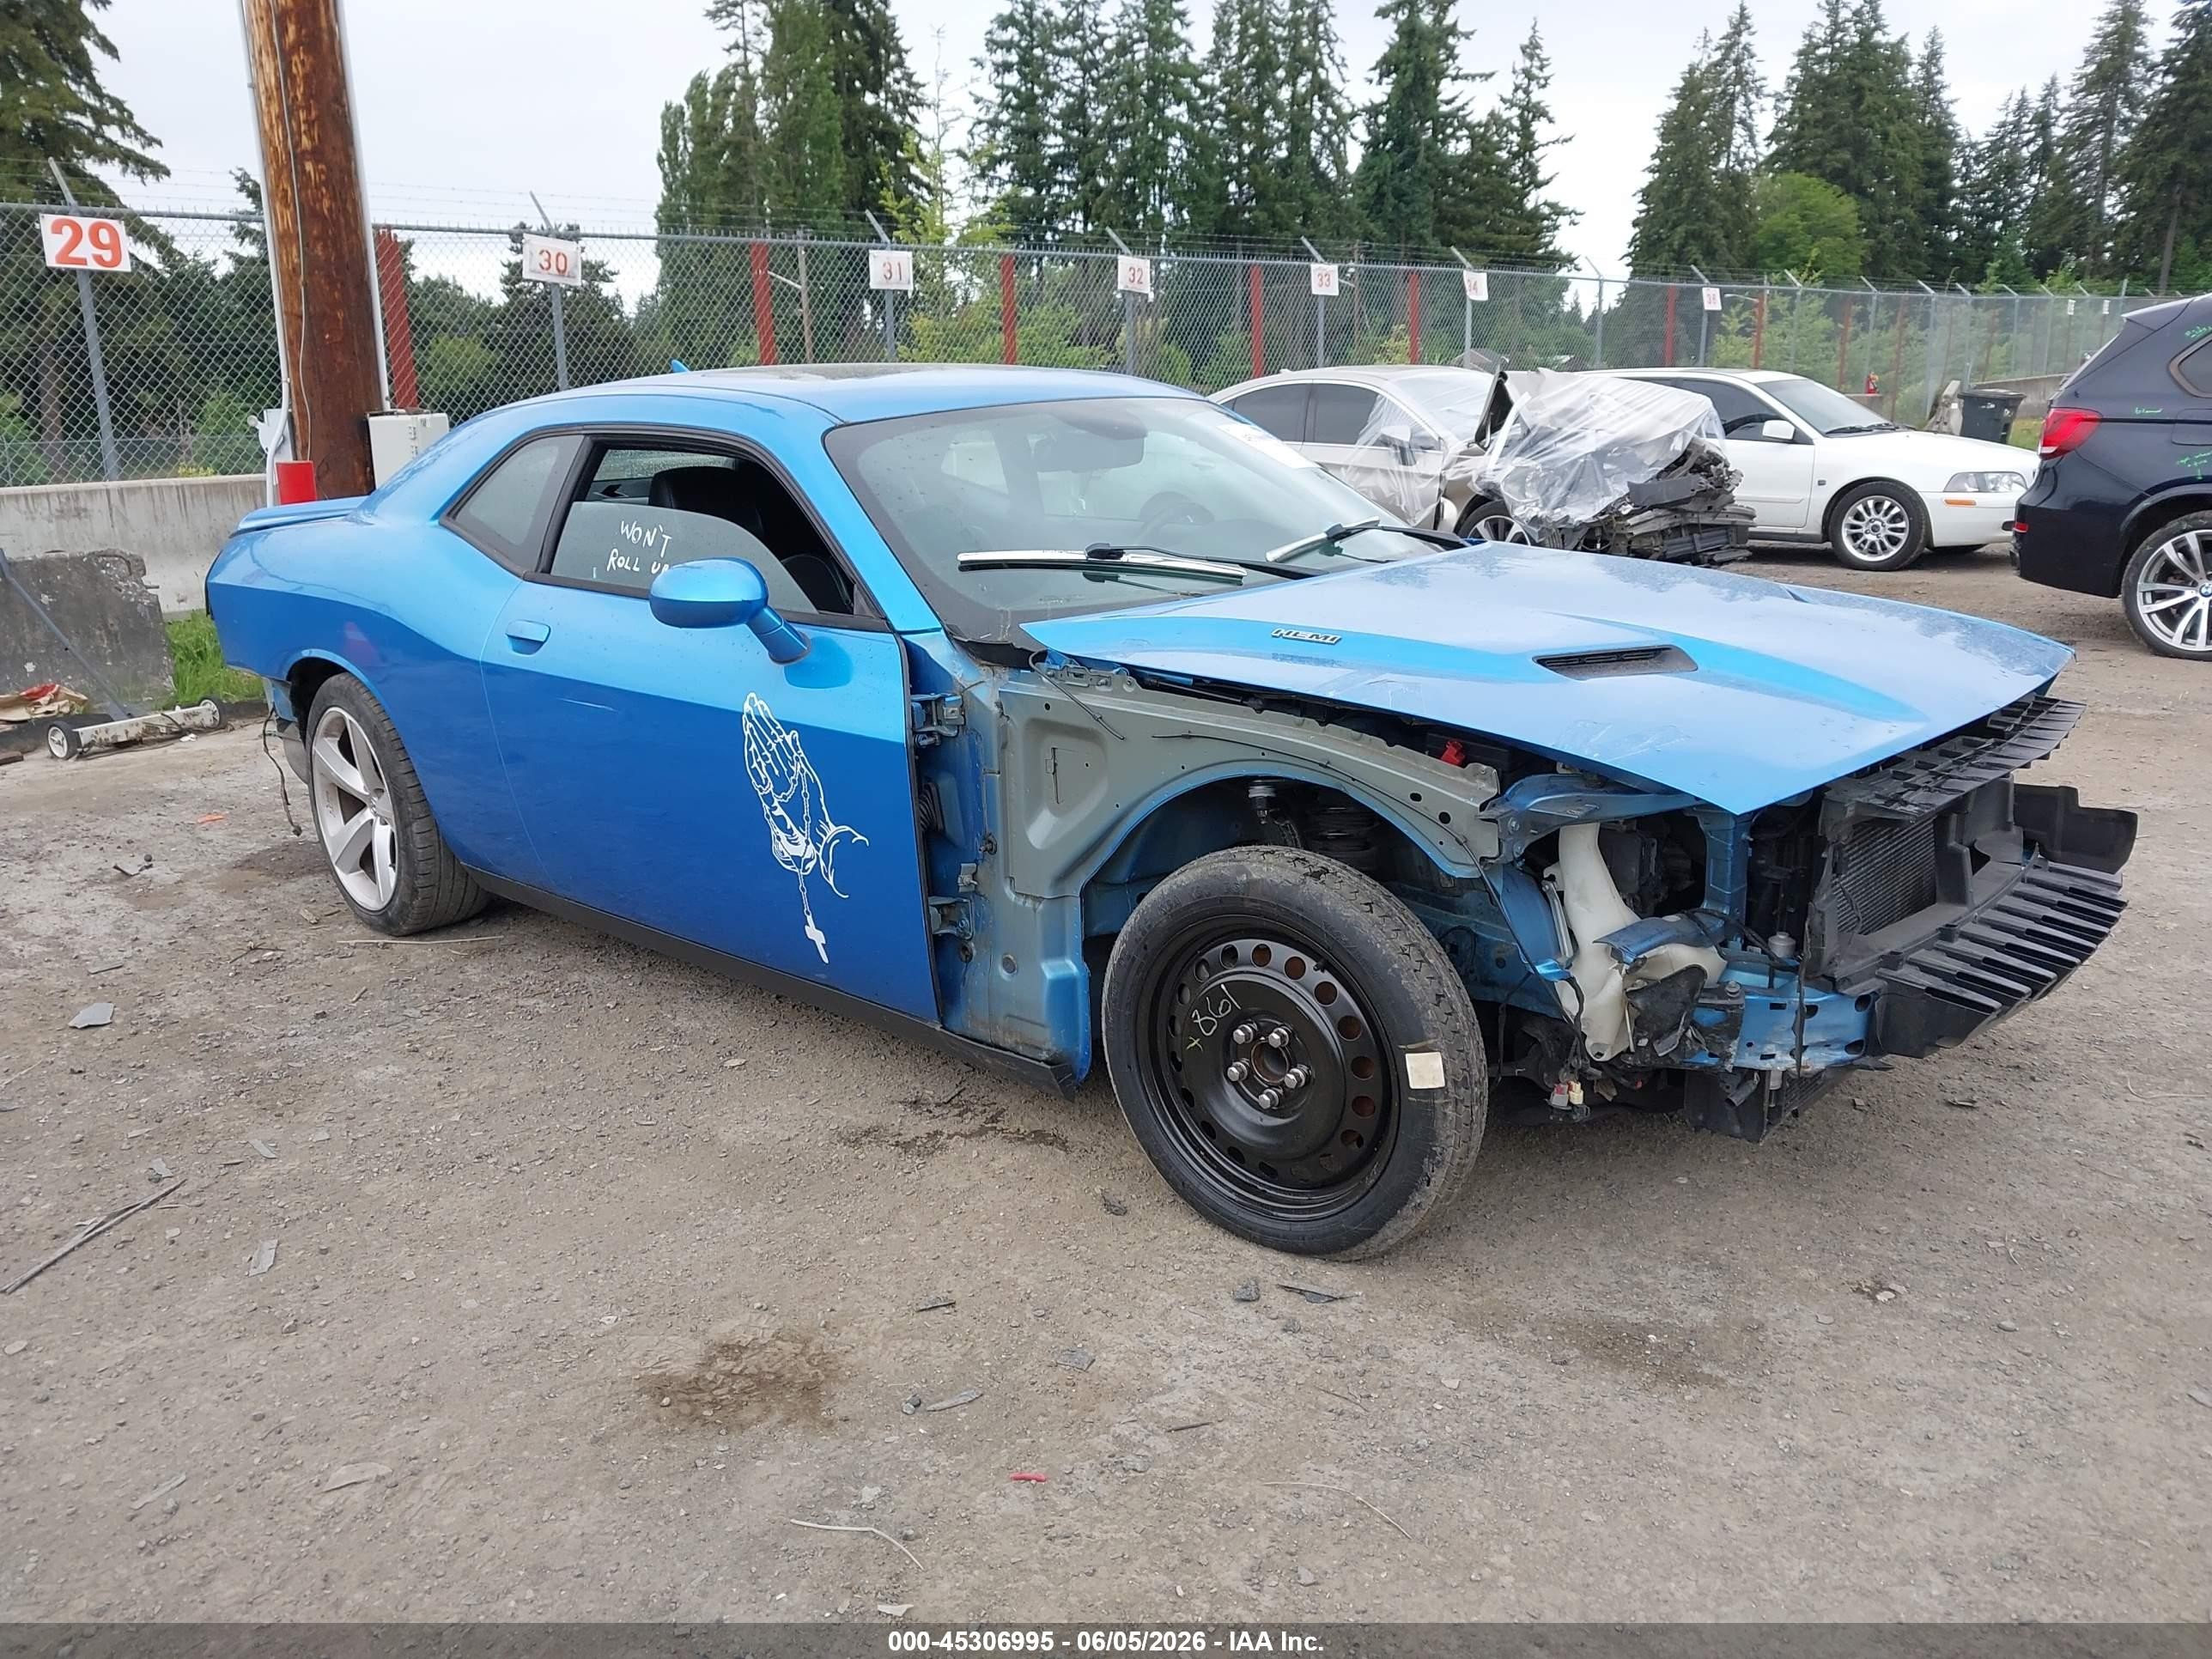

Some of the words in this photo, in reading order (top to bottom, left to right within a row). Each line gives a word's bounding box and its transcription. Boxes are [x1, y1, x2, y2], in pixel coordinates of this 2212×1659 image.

[51, 217, 123, 269] 29
[538, 249, 568, 275] 30
[883, 261, 902, 282] 31
[1128, 266, 1144, 284] 32
[1317, 273, 1331, 288] 33
[620, 520, 672, 558] WON'T
[606, 548, 641, 572] ROLL
[1271, 628, 1343, 645] HEMI
